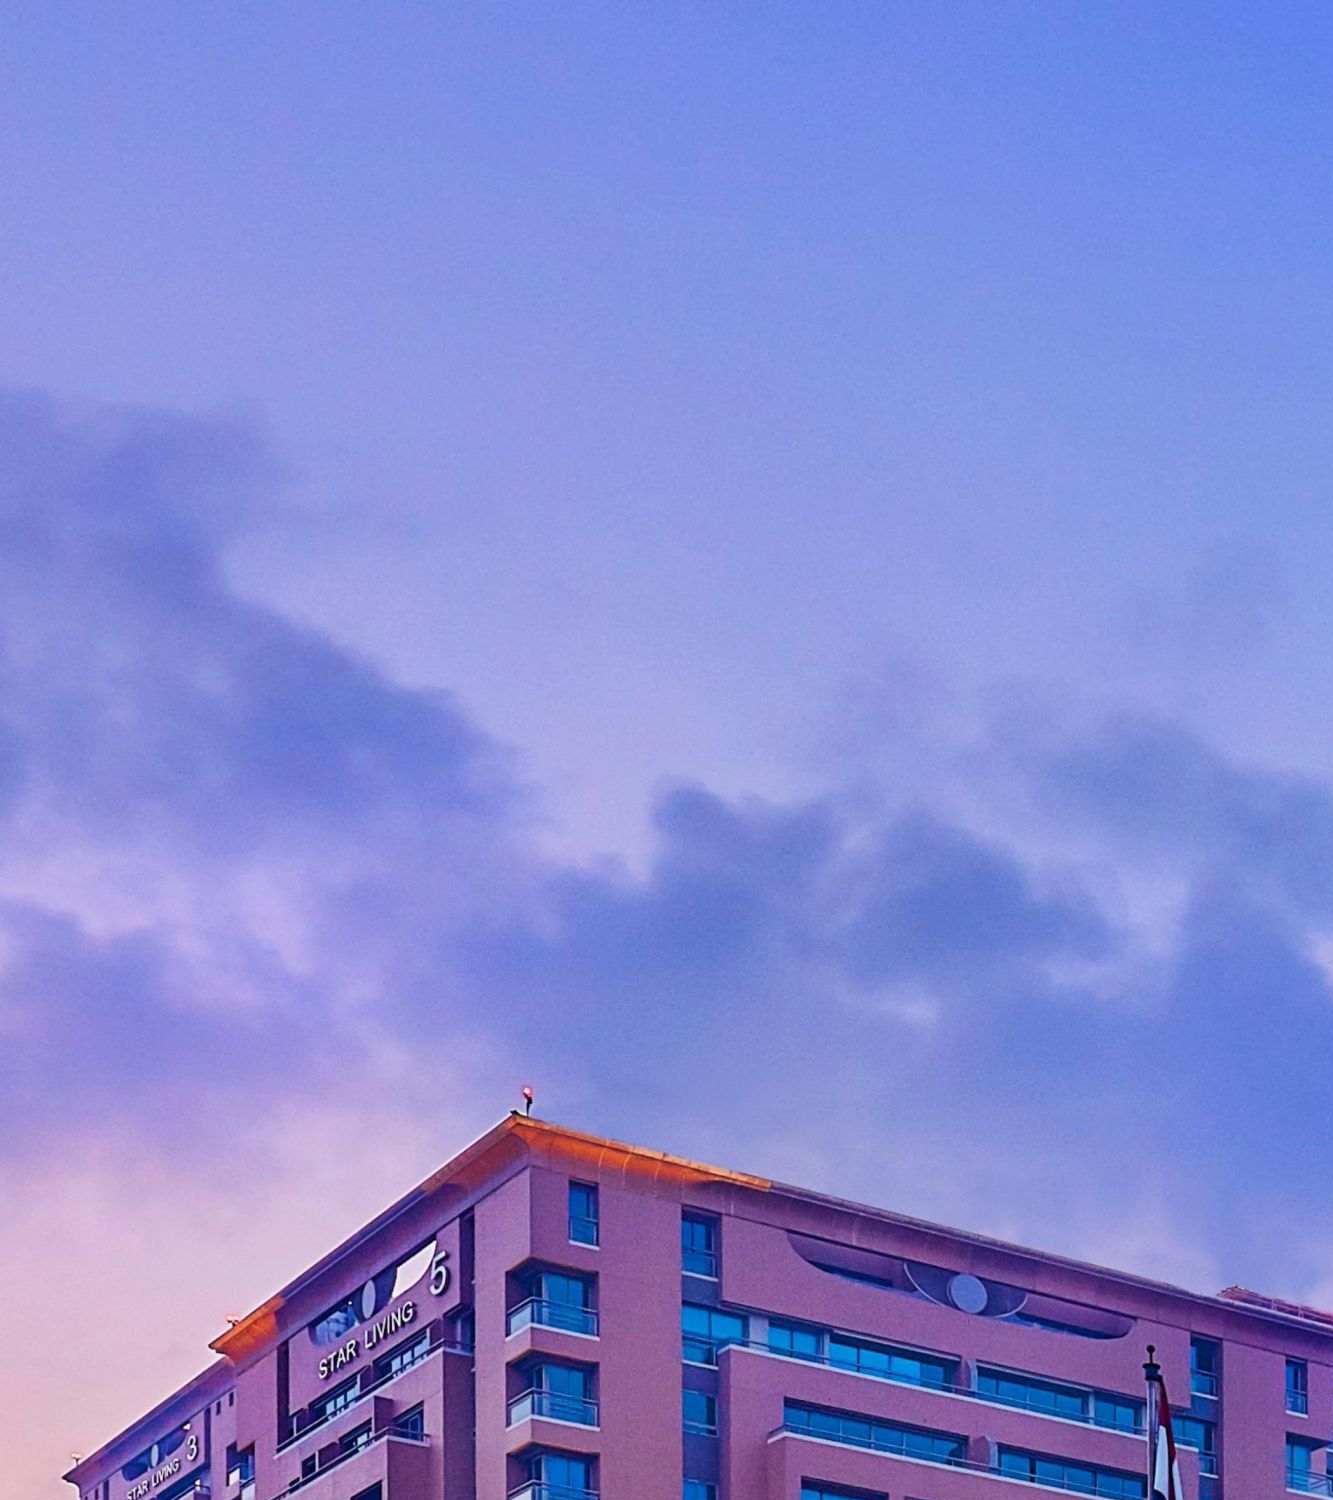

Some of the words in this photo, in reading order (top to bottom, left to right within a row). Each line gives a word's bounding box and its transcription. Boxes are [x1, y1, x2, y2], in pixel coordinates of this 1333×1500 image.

[318, 1339, 358, 1380] STAR
[363, 1300, 415, 1350] LIVING
[429, 1250, 448, 1296] 5
[151, 1458, 181, 1487] LIVING
[186, 1434, 198, 1461] 3
